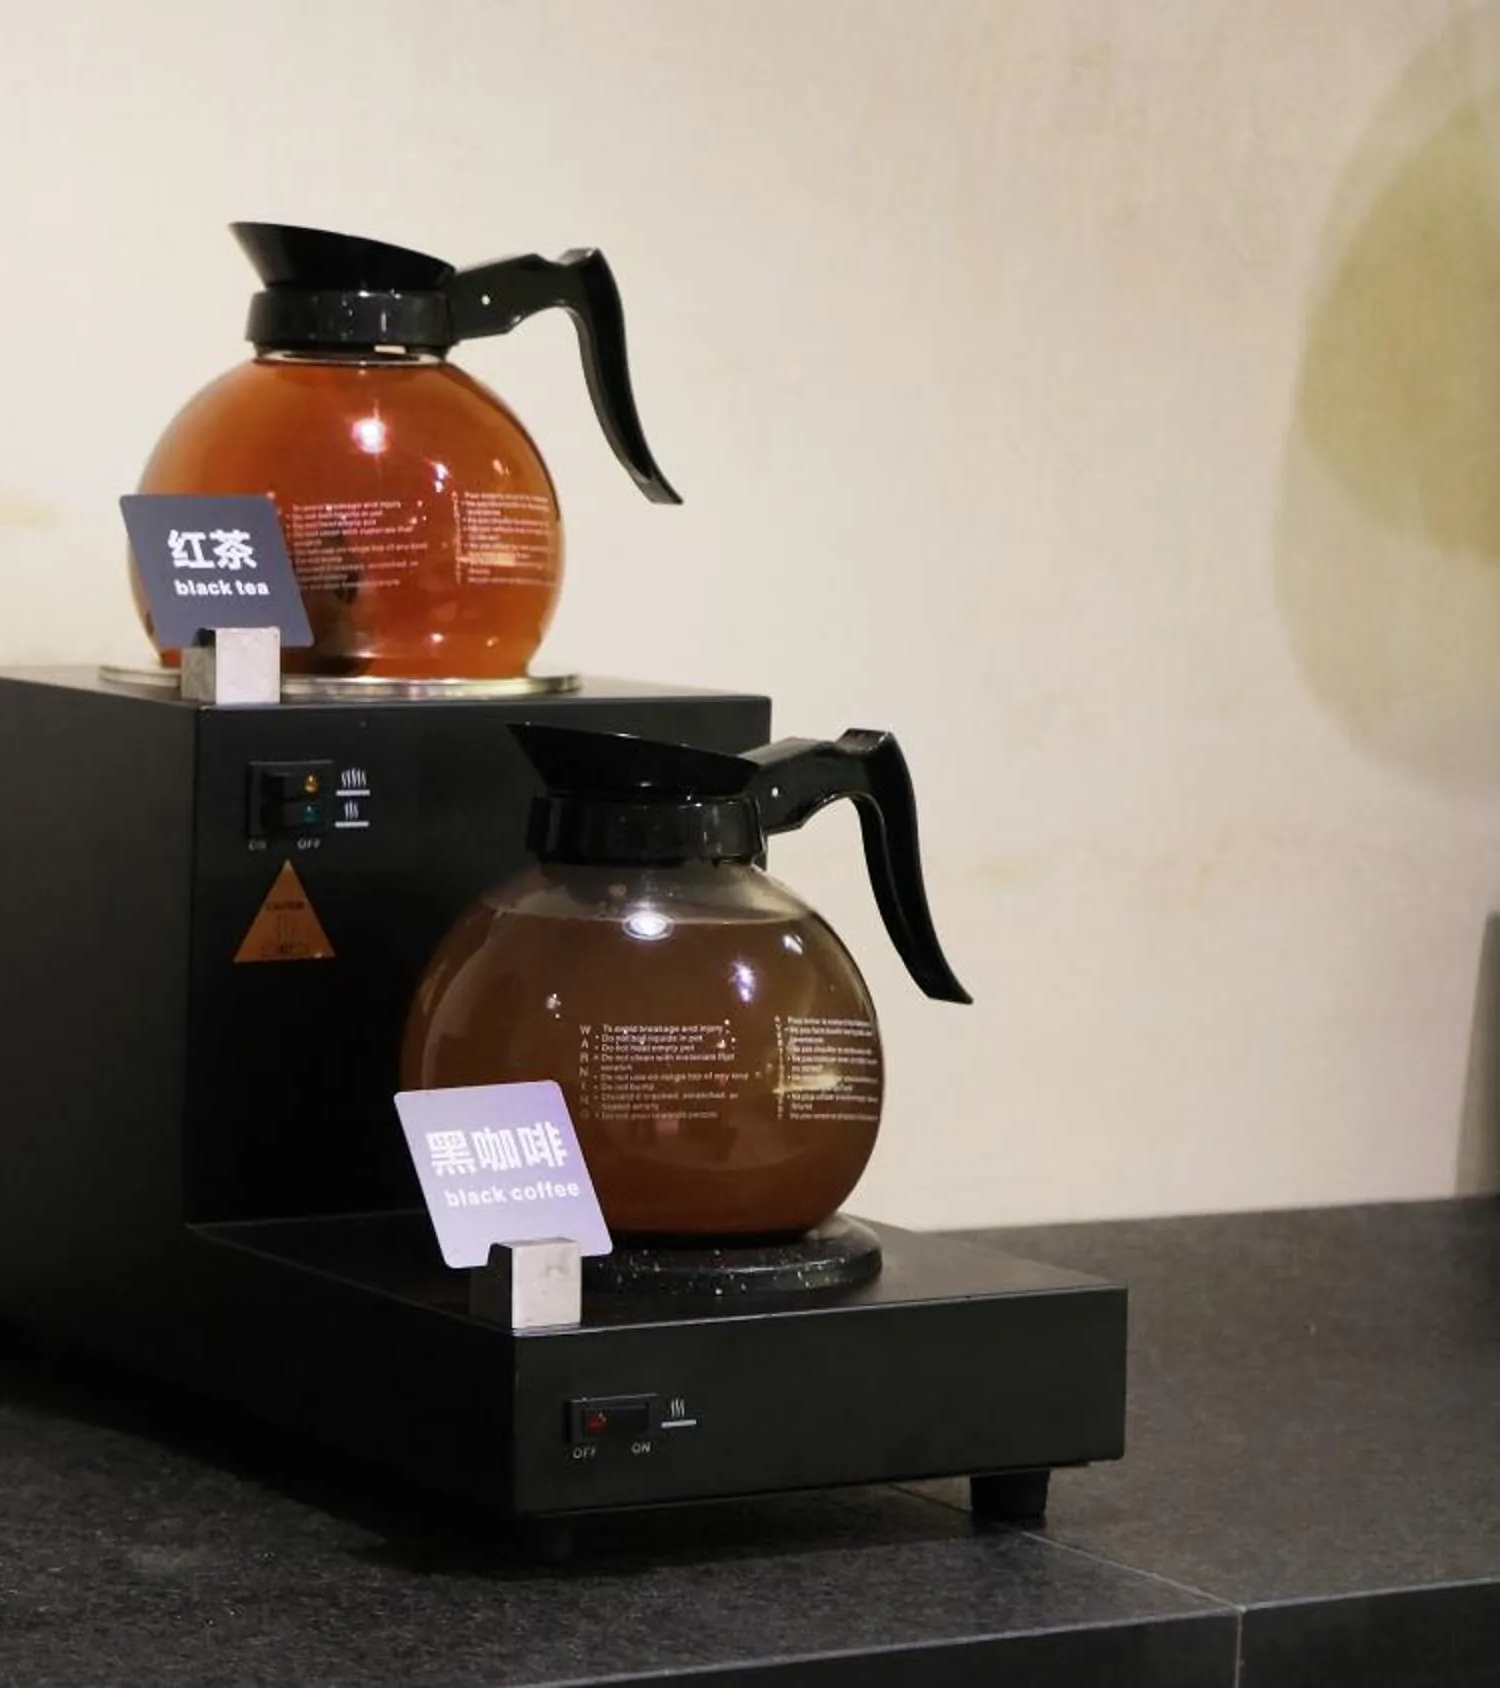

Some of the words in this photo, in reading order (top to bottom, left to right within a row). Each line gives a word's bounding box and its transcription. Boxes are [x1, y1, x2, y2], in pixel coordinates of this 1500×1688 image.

[167, 529, 257, 569] 红茶
[174, 580, 233, 596] black
[236, 581, 271, 596] tea
[425, 1121, 568, 1176] 黑咖啡
[444, 1186, 508, 1207] black
[510, 1181, 581, 1201] coffee
[630, 1441, 651, 1454] ON
